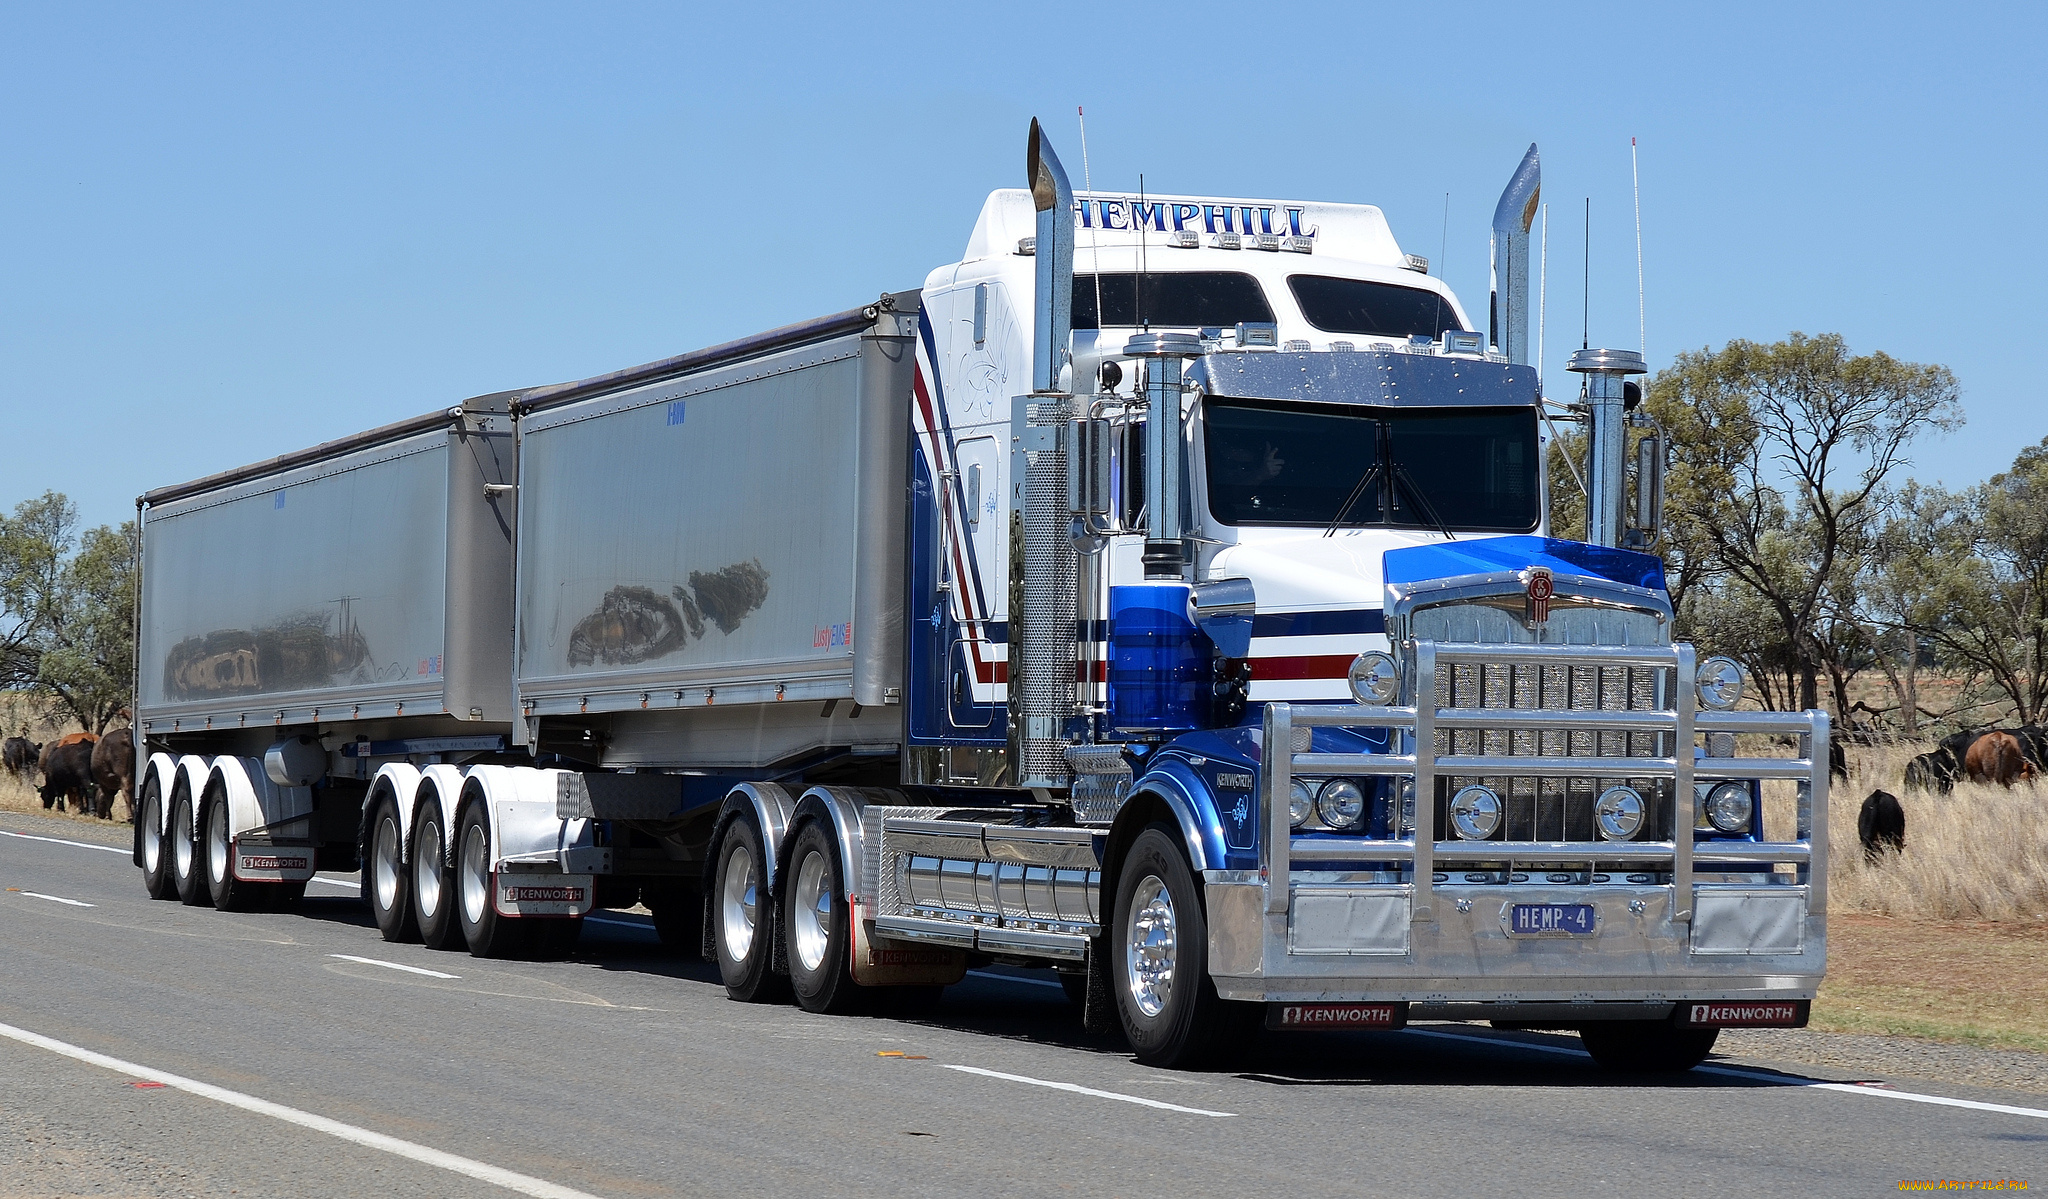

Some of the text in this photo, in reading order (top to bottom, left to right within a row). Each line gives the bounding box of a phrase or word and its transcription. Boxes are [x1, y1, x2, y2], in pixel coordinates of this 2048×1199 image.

[1217, 772, 1253, 788] KENWORTH
[254, 858, 306, 867] KENWORTH
[520, 889, 582, 900] KENWORTH
[1303, 1008, 1391, 1022] KENWORTH
[1710, 1007, 1794, 1021] KENWORTH
